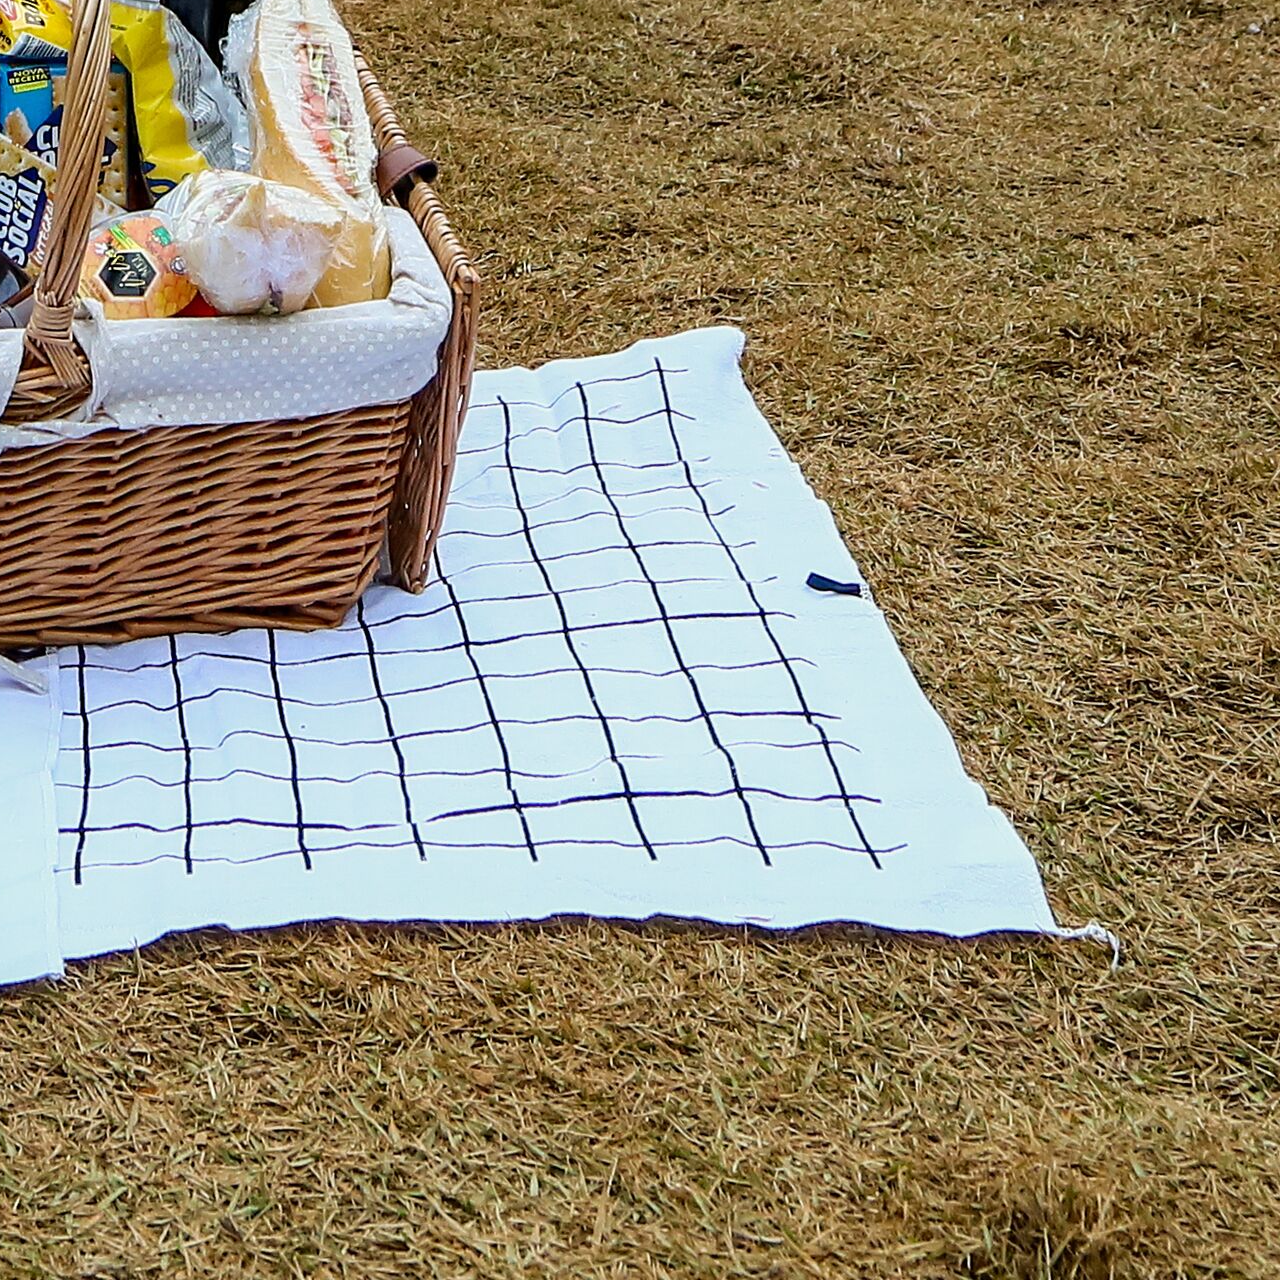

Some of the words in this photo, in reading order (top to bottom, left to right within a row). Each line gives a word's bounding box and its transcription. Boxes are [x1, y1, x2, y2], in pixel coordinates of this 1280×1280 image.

[9, 73, 49, 85] RECEITA
[13, 68, 45, 78] NOVA
[36, 124, 60, 151] CL
[2, 176, 43, 266] SOCIAL
